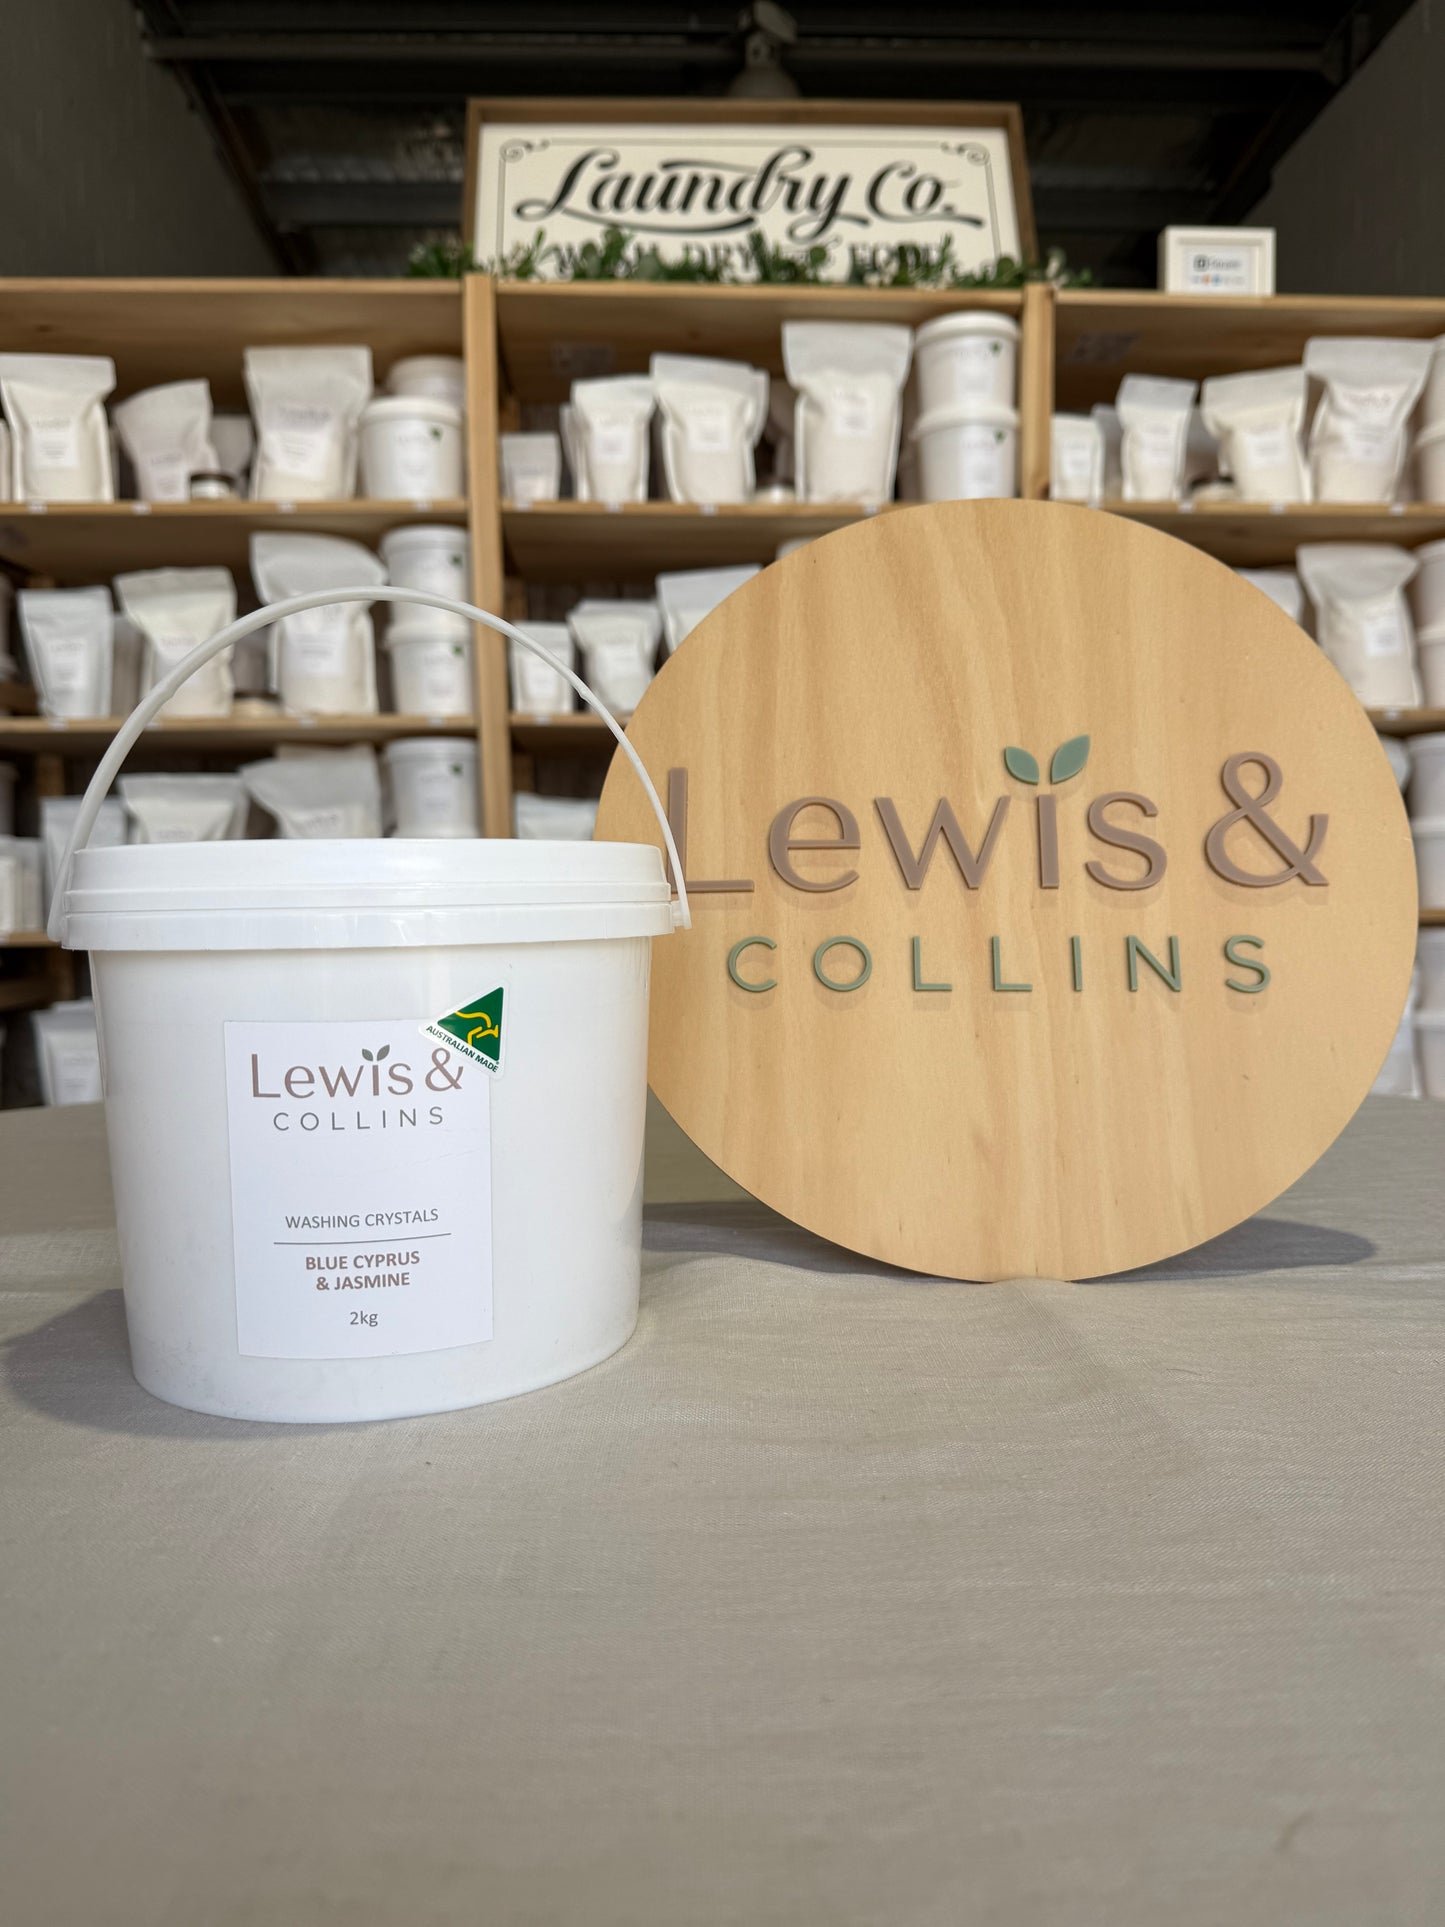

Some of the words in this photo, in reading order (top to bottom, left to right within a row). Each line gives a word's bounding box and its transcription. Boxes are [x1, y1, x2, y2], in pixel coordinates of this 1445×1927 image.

[514, 146, 870, 244] Laundry
[865, 161, 984, 227] Co.
[667, 768, 1167, 893] Lewis
[1204, 751, 1329, 888] &
[727, 934, 1271, 993] COLLINS
[426, 1025, 476, 1058] AUSTRALIAN
[474, 1054, 499, 1073] MADE
[251, 1053, 413, 1099] Lewis
[424, 1047, 464, 1092] &
[273, 1106, 444, 1131] COLLINS
[285, 1214, 361, 1229] WASHING
[364, 1208, 439, 1227] CRYSTALS
[305, 1255, 348, 1271] BLUE
[352, 1250, 420, 1269] CYPRUS
[316, 1276, 330, 1291] &
[334, 1272, 410, 1290] JASMINE
[349, 1311, 379, 1327] 2kg
